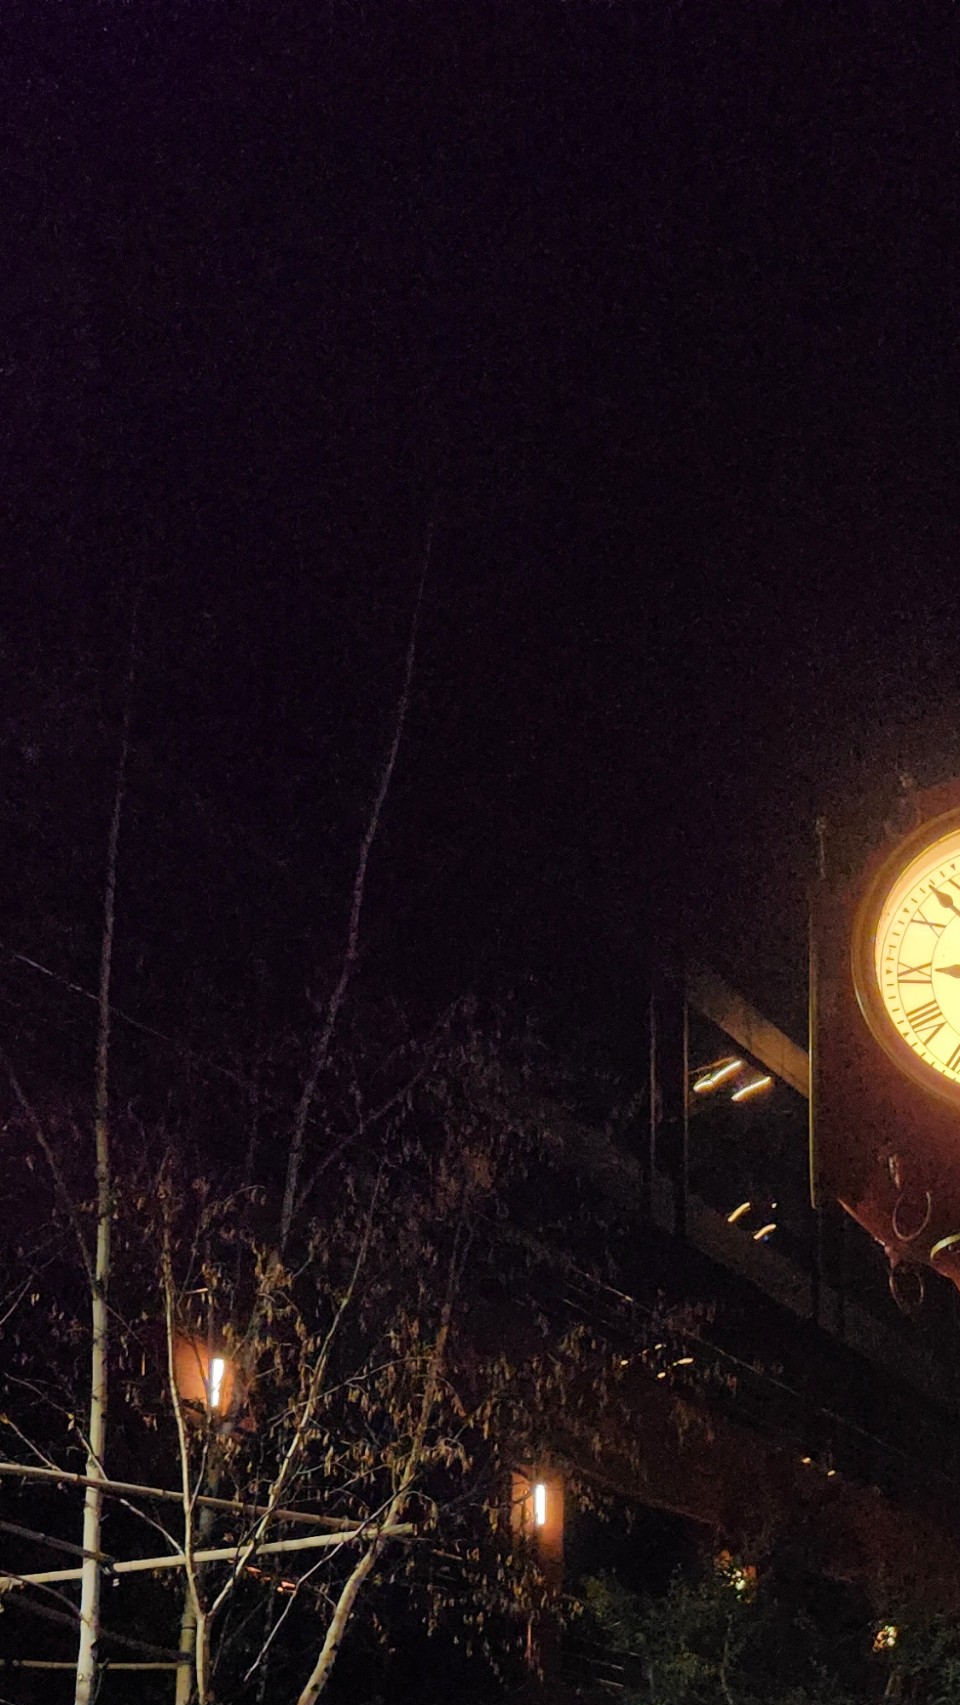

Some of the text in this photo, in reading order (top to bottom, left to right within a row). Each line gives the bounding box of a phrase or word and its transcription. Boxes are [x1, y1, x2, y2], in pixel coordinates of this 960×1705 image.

[911, 909, 946, 937] X
[897, 962, 932, 983] IX
[906, 1000, 947, 1046] VIII
